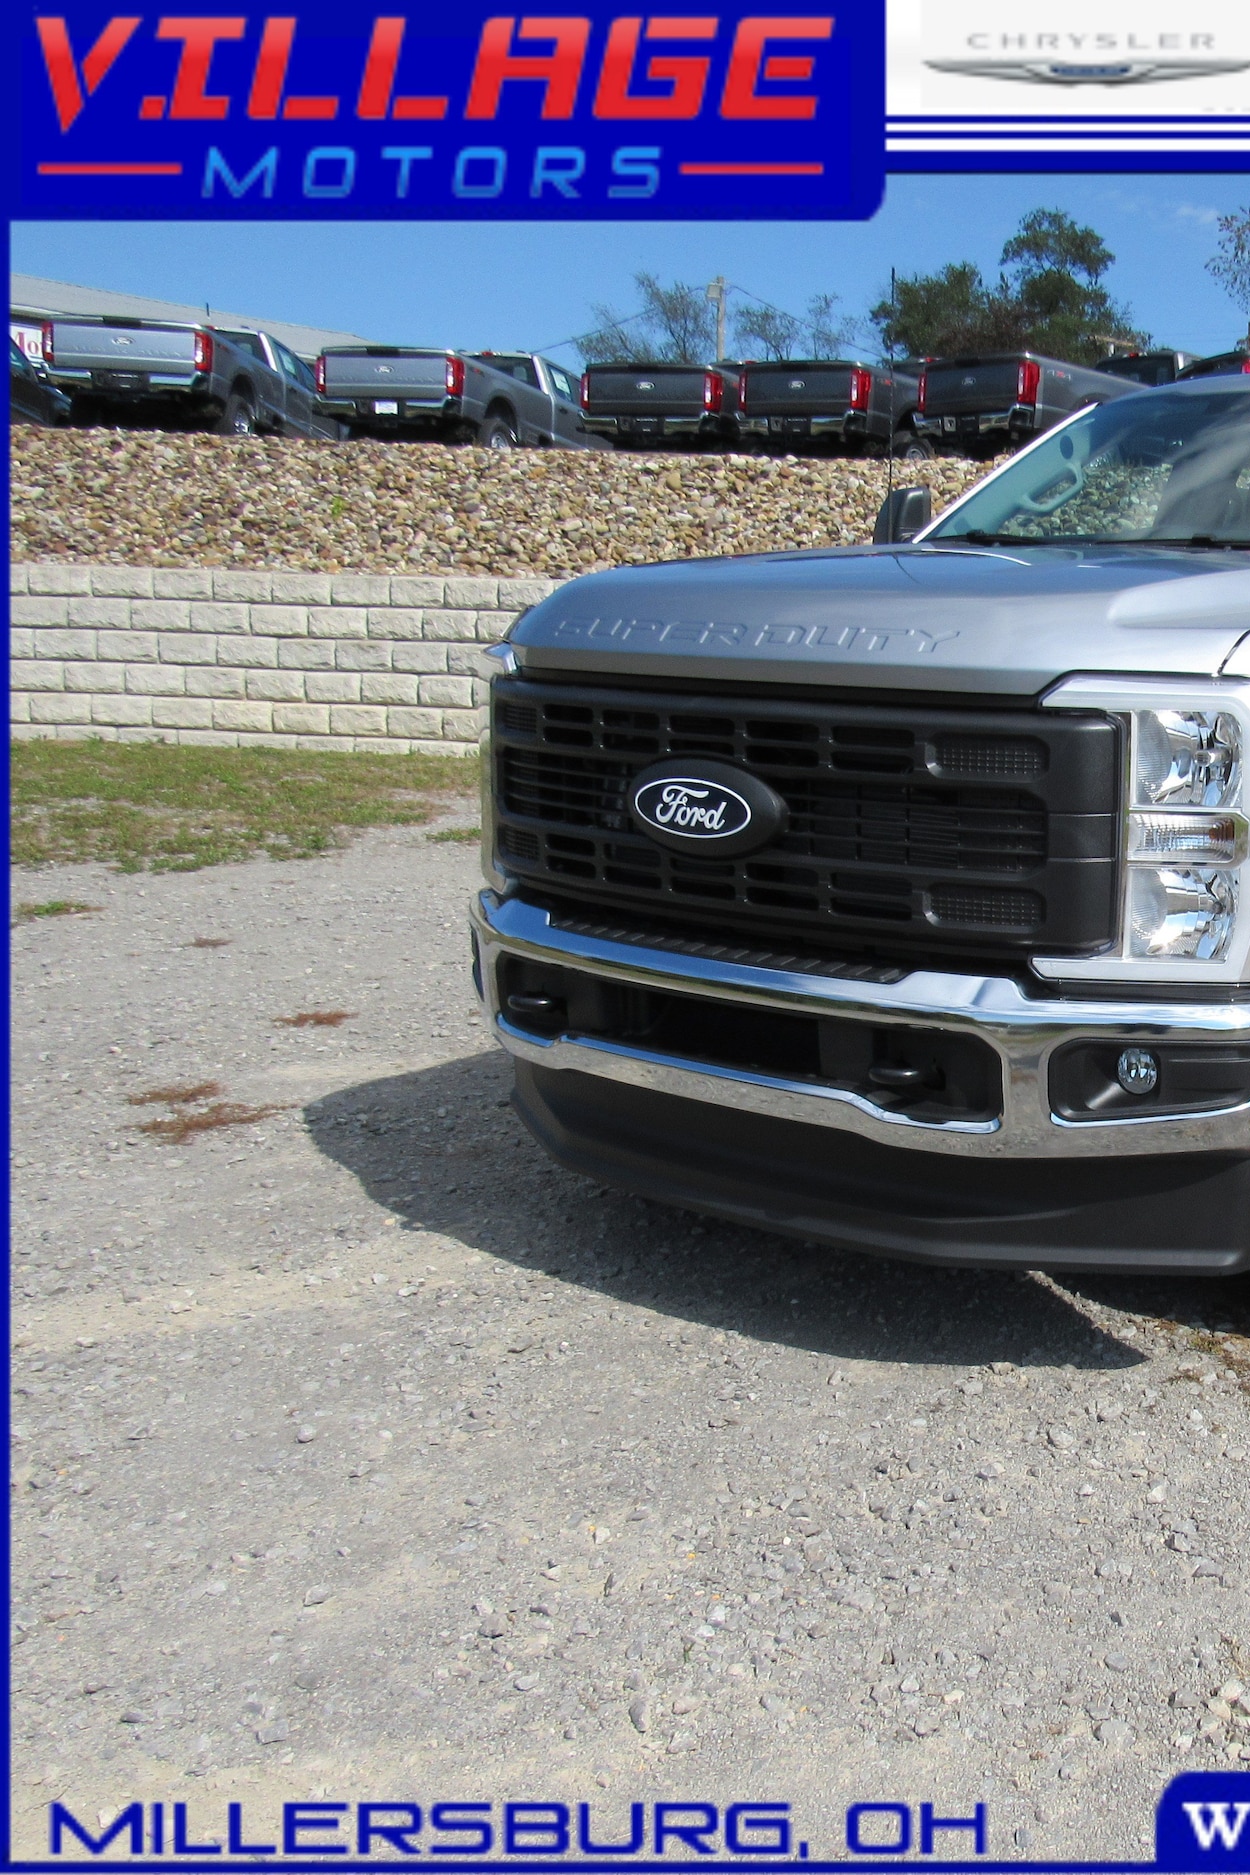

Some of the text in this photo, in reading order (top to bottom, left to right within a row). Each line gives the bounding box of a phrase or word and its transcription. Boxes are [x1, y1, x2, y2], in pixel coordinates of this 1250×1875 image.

[553, 617, 961, 654] SUPER DUTY
[656, 785, 727, 830] Ford
